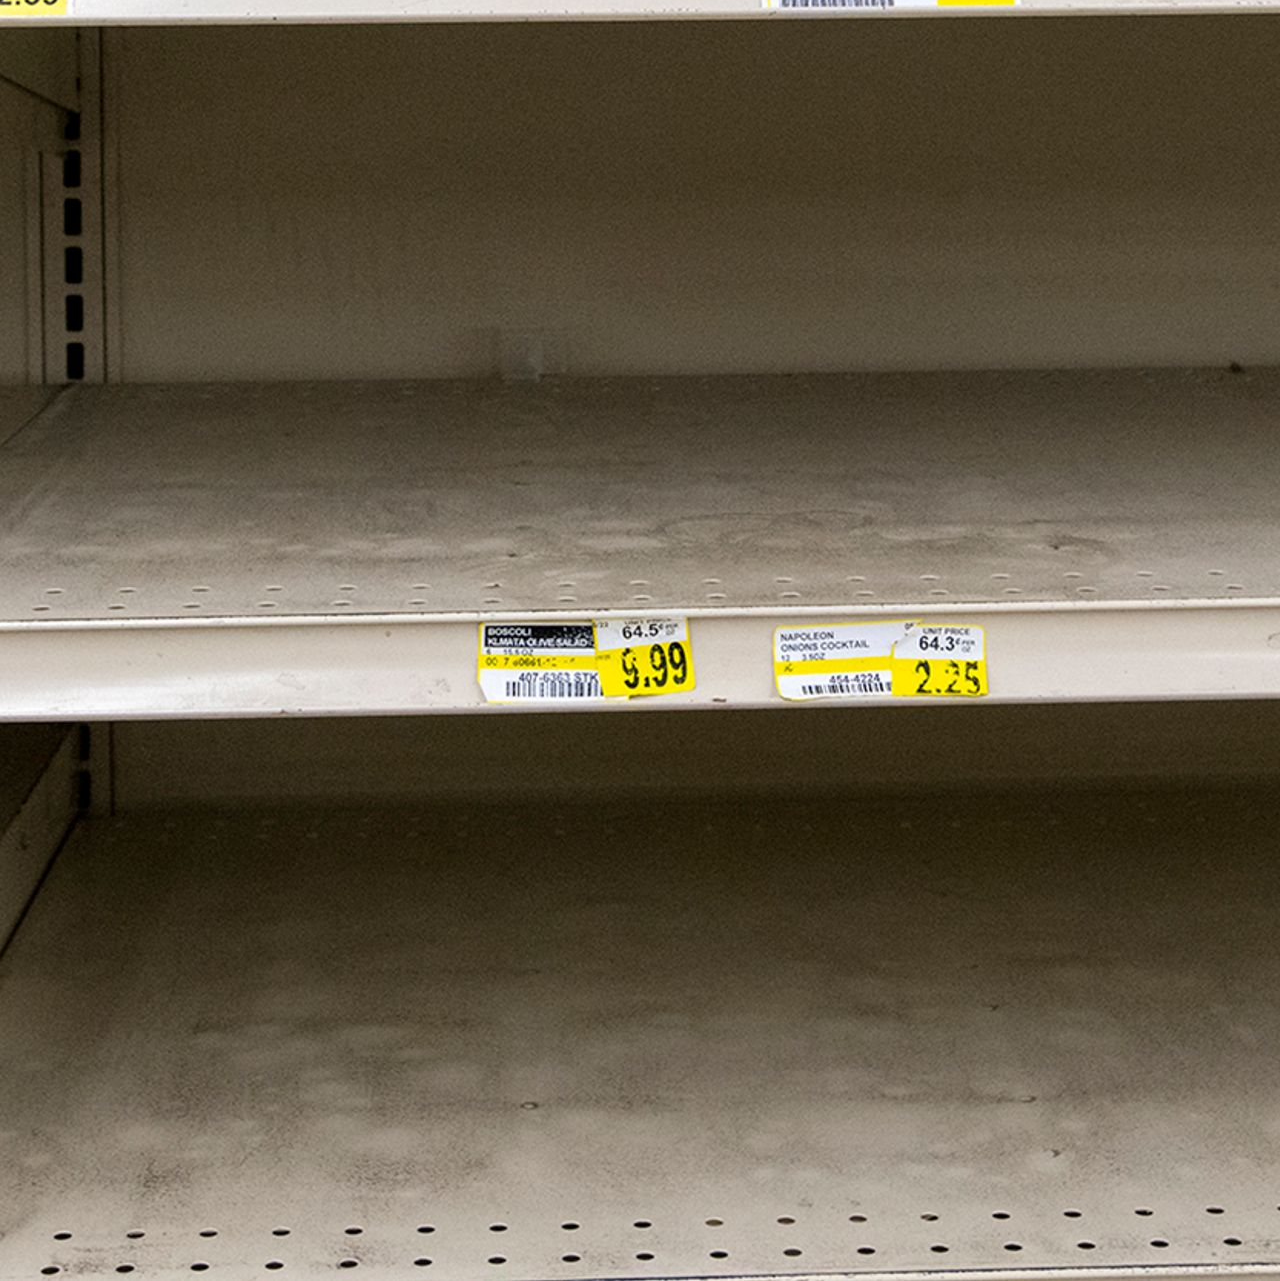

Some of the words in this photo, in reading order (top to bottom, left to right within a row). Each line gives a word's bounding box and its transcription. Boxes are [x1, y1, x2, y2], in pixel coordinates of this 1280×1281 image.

[780, 631, 834, 642] NAPOLEON
[781, 642, 820, 653] ONIONS
[821, 640, 869, 650] COCKTAIL
[575, 672, 598, 682] STK
[915, 660, 981, 695] 2.25
